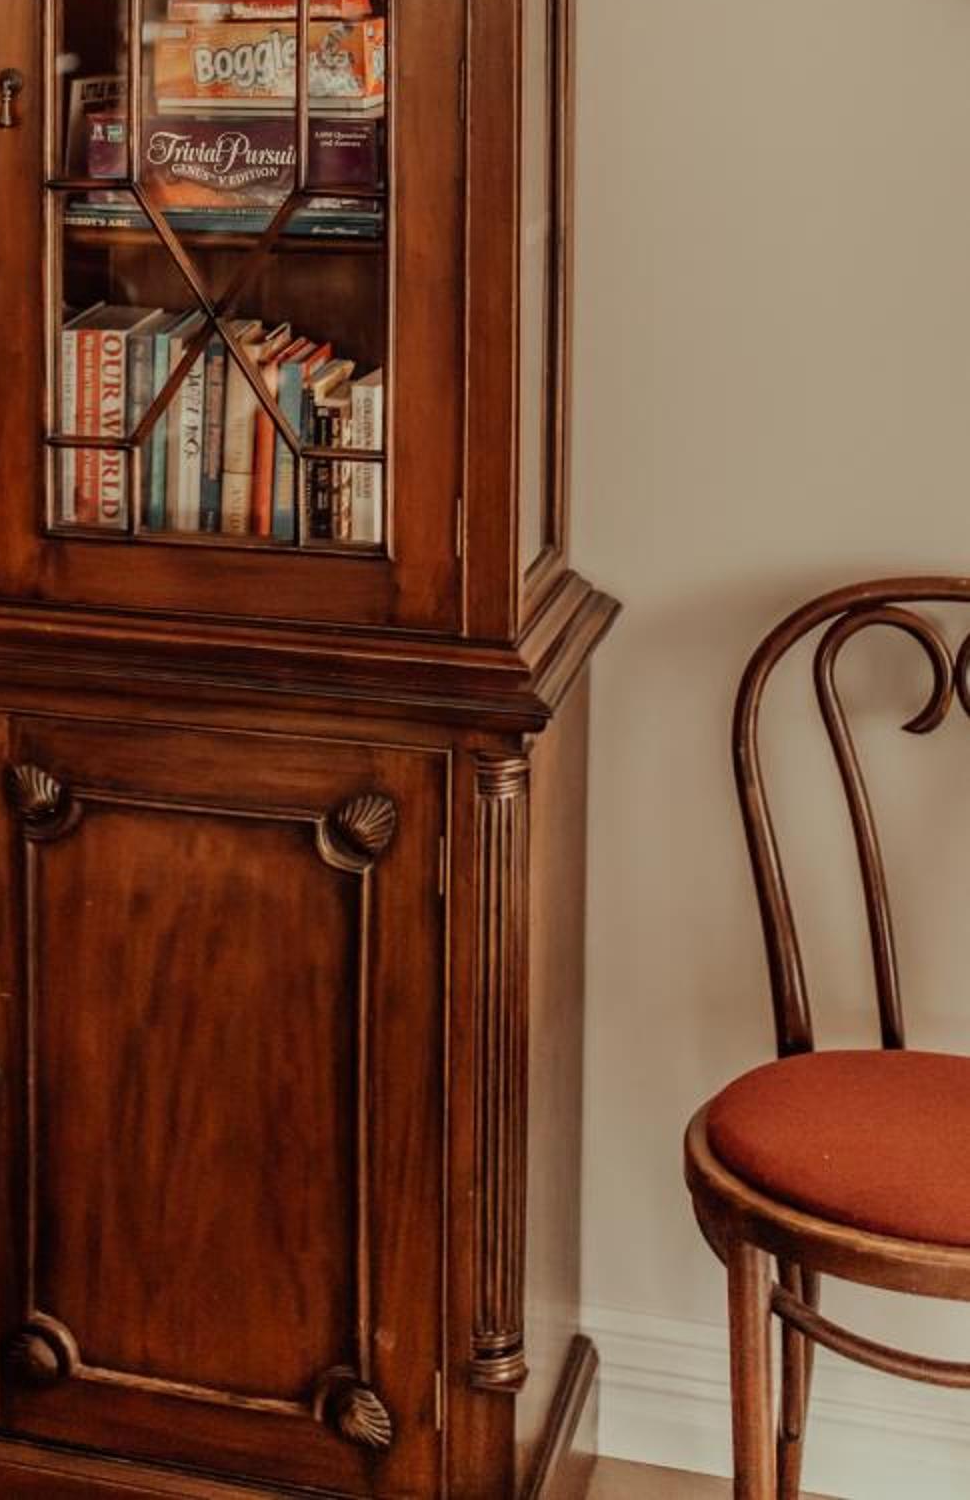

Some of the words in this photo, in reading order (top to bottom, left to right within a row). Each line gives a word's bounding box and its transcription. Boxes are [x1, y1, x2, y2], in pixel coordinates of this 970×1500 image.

[194, 32, 297, 87] Boggle
[149, 131, 223, 165] Trivial
[102, 335, 123, 401] OUR
